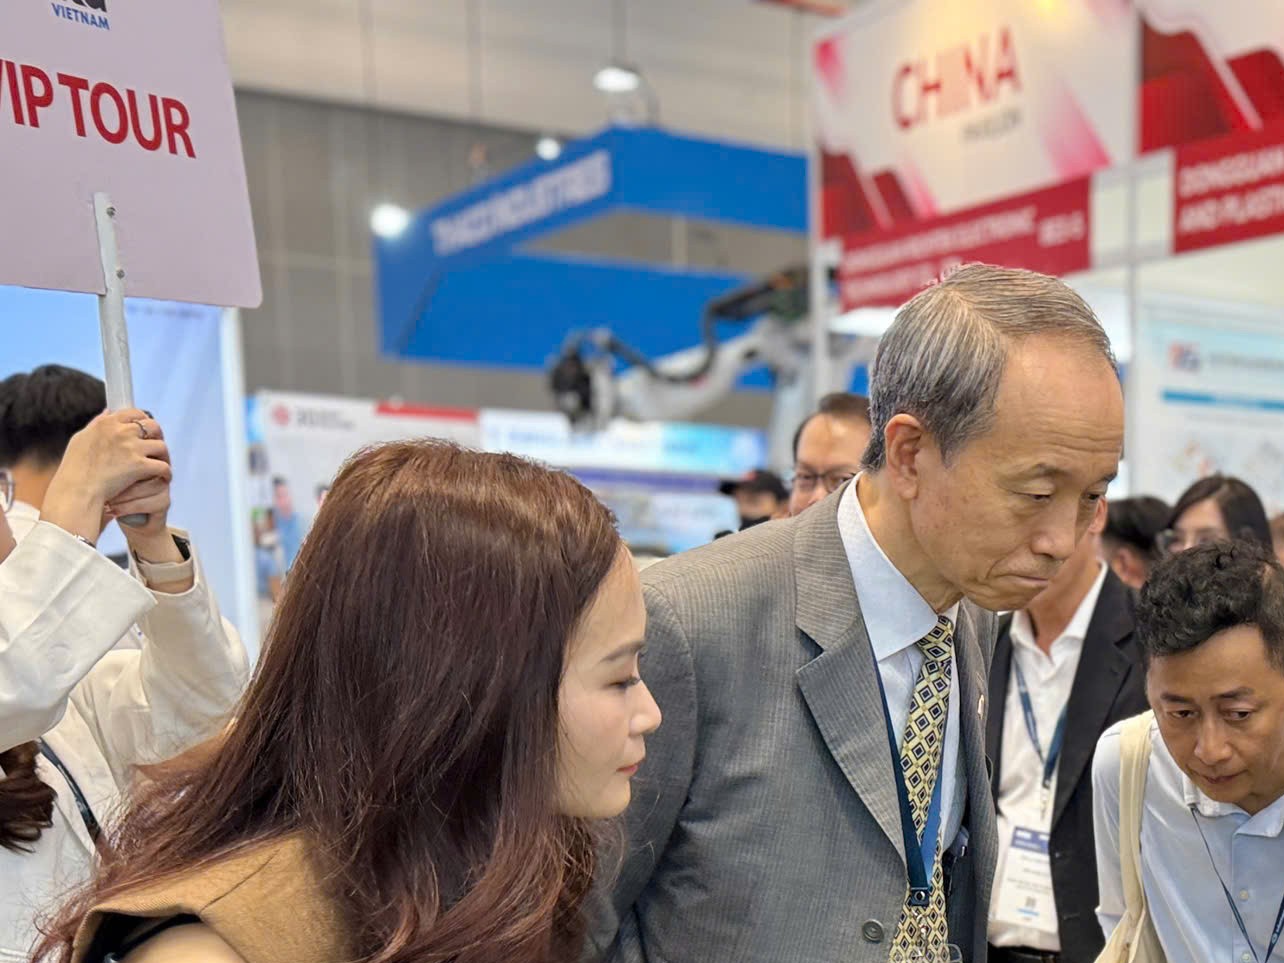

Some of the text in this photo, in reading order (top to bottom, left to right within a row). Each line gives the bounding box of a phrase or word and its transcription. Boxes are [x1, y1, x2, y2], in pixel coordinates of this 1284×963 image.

[52, 3, 110, 30] VIETNAM
[57, 72, 197, 159] TOUR
[891, 27, 1022, 131] CHINA
